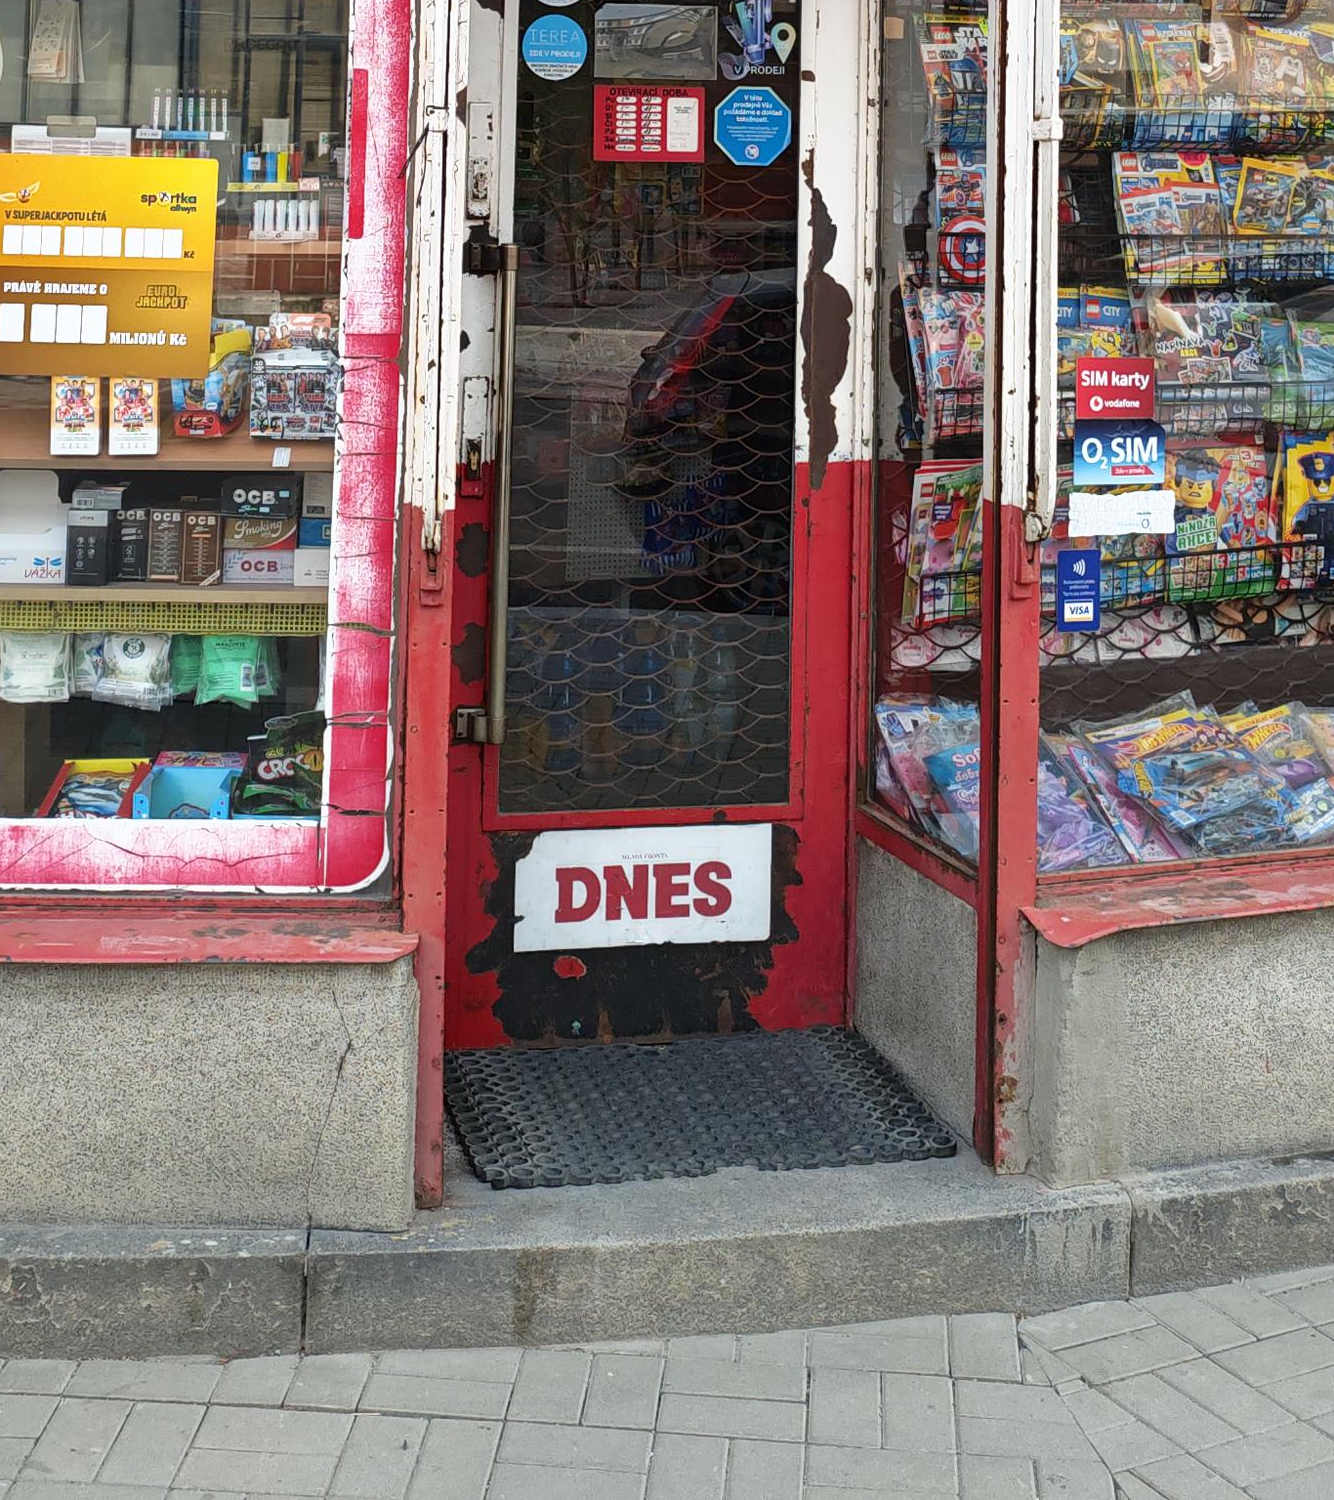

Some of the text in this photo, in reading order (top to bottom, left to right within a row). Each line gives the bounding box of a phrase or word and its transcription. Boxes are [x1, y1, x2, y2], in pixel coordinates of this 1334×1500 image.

[528, 29, 581, 43] TEREA
[662, 88, 688, 97] DOBA
[170, 204, 197, 213] allwyn
[5, 210, 107, 221] V SUPERJACKPOTU LÉTÁ
[184, 251, 195, 259] Kč
[44, 283, 96, 295] HRAJEME
[99, 284, 107, 294] O
[147, 285, 177, 296] EURO
[136, 296, 187, 309] JACKPOT
[1102, 305, 1121, 316] CITY
[109, 331, 187, 346] MILIONŮ Kč
[1081, 368, 1150, 391] SIM karty
[1104, 398, 1140, 409] vodafone
[1111, 437, 1158, 464] SIM
[233, 489, 276, 504] OCB
[117, 511, 145, 520] OCB
[153, 512, 181, 521] OCB
[188, 516, 216, 525] OCB
[234, 520, 282, 539] Smoking
[241, 561, 278, 572] OCB
[1069, 606, 1090, 615] VISA
[555, 861, 732, 923] DNES
